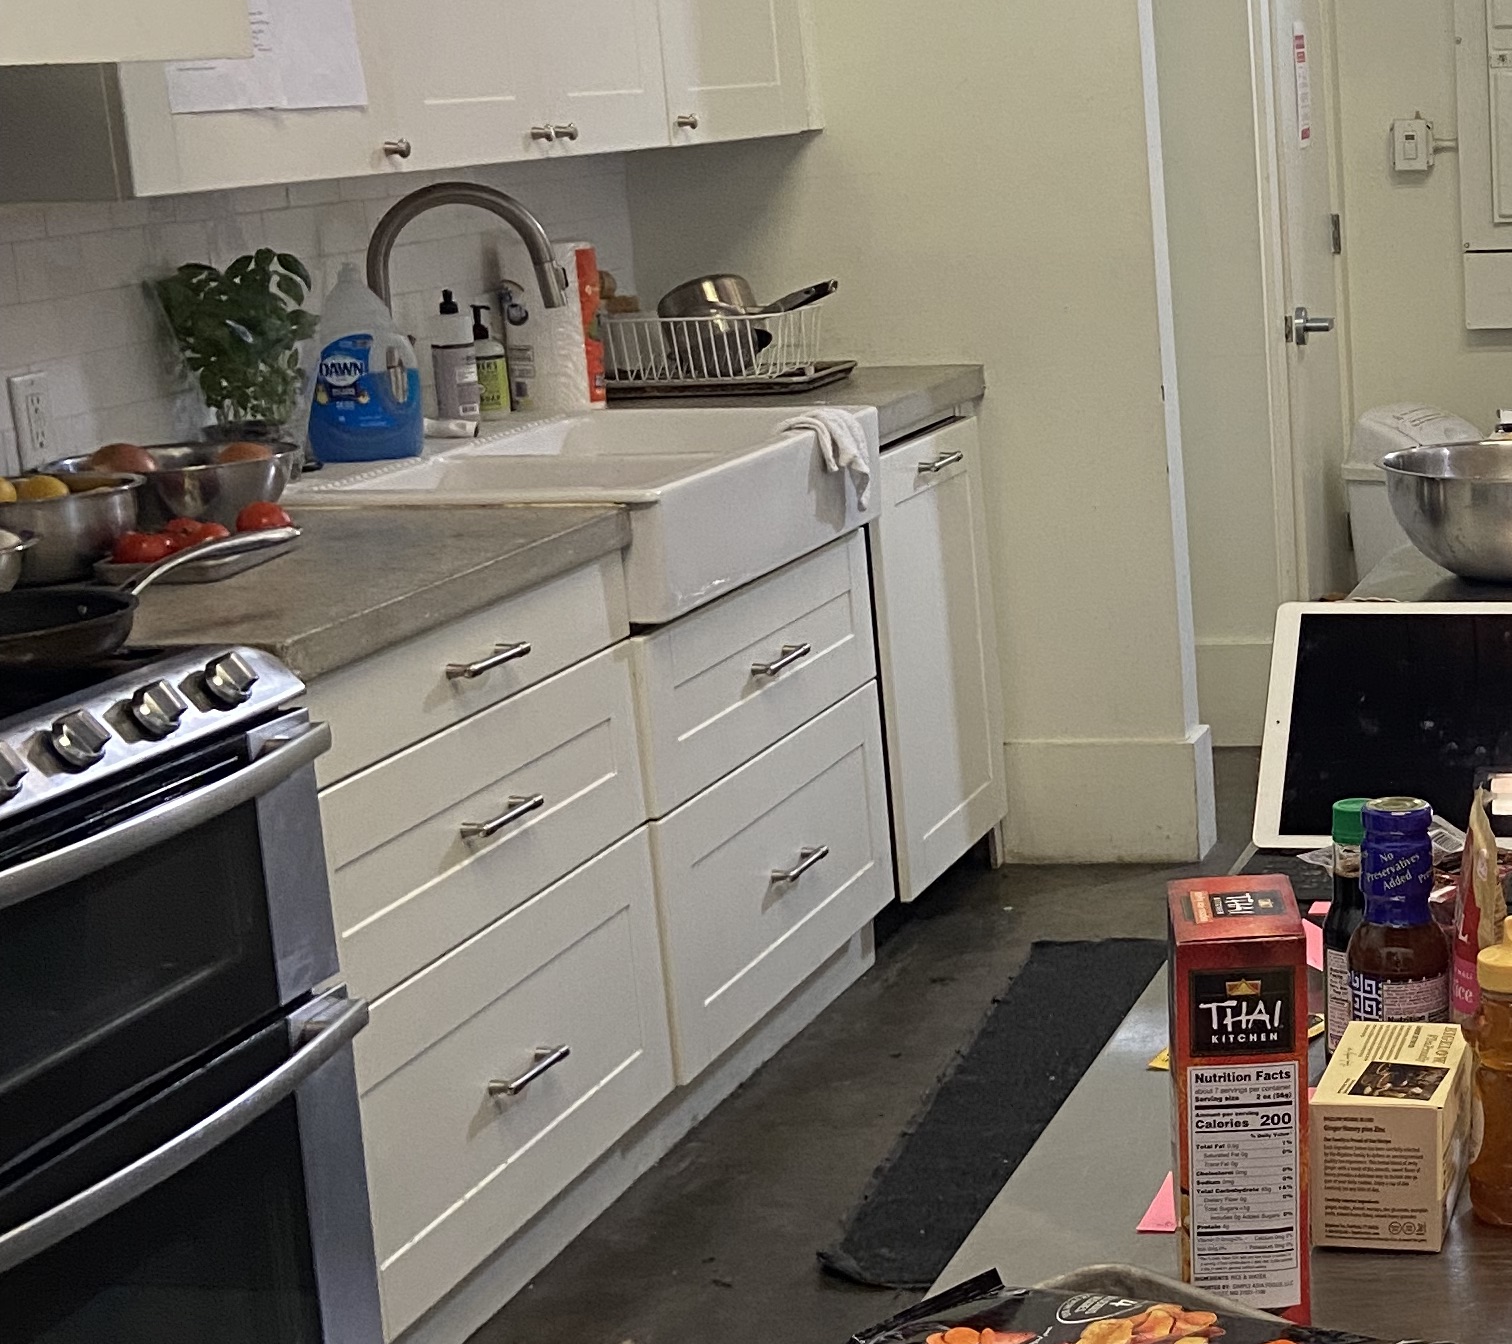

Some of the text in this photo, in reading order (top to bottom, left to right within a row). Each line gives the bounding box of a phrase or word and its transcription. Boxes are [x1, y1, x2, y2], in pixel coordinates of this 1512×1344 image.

[319, 360, 366, 379] DAWN
[1379, 851, 1395, 863] No
[1365, 852, 1421, 883] Preservatives
[1382, 871, 1413, 892] Added
[1223, 892, 1255, 916] THAI
[1199, 999, 1282, 1033] THAI
[1211, 1032, 1278, 1044] KITCHEN
[1194, 1069, 1292, 1084] Nutrition Facts
[1194, 1087, 1213, 1095] about
[1220, 1086, 1248, 1095] servings
[1248, 1086, 1260, 1094] per
[1195, 1112, 1292, 1130] Calories 200
